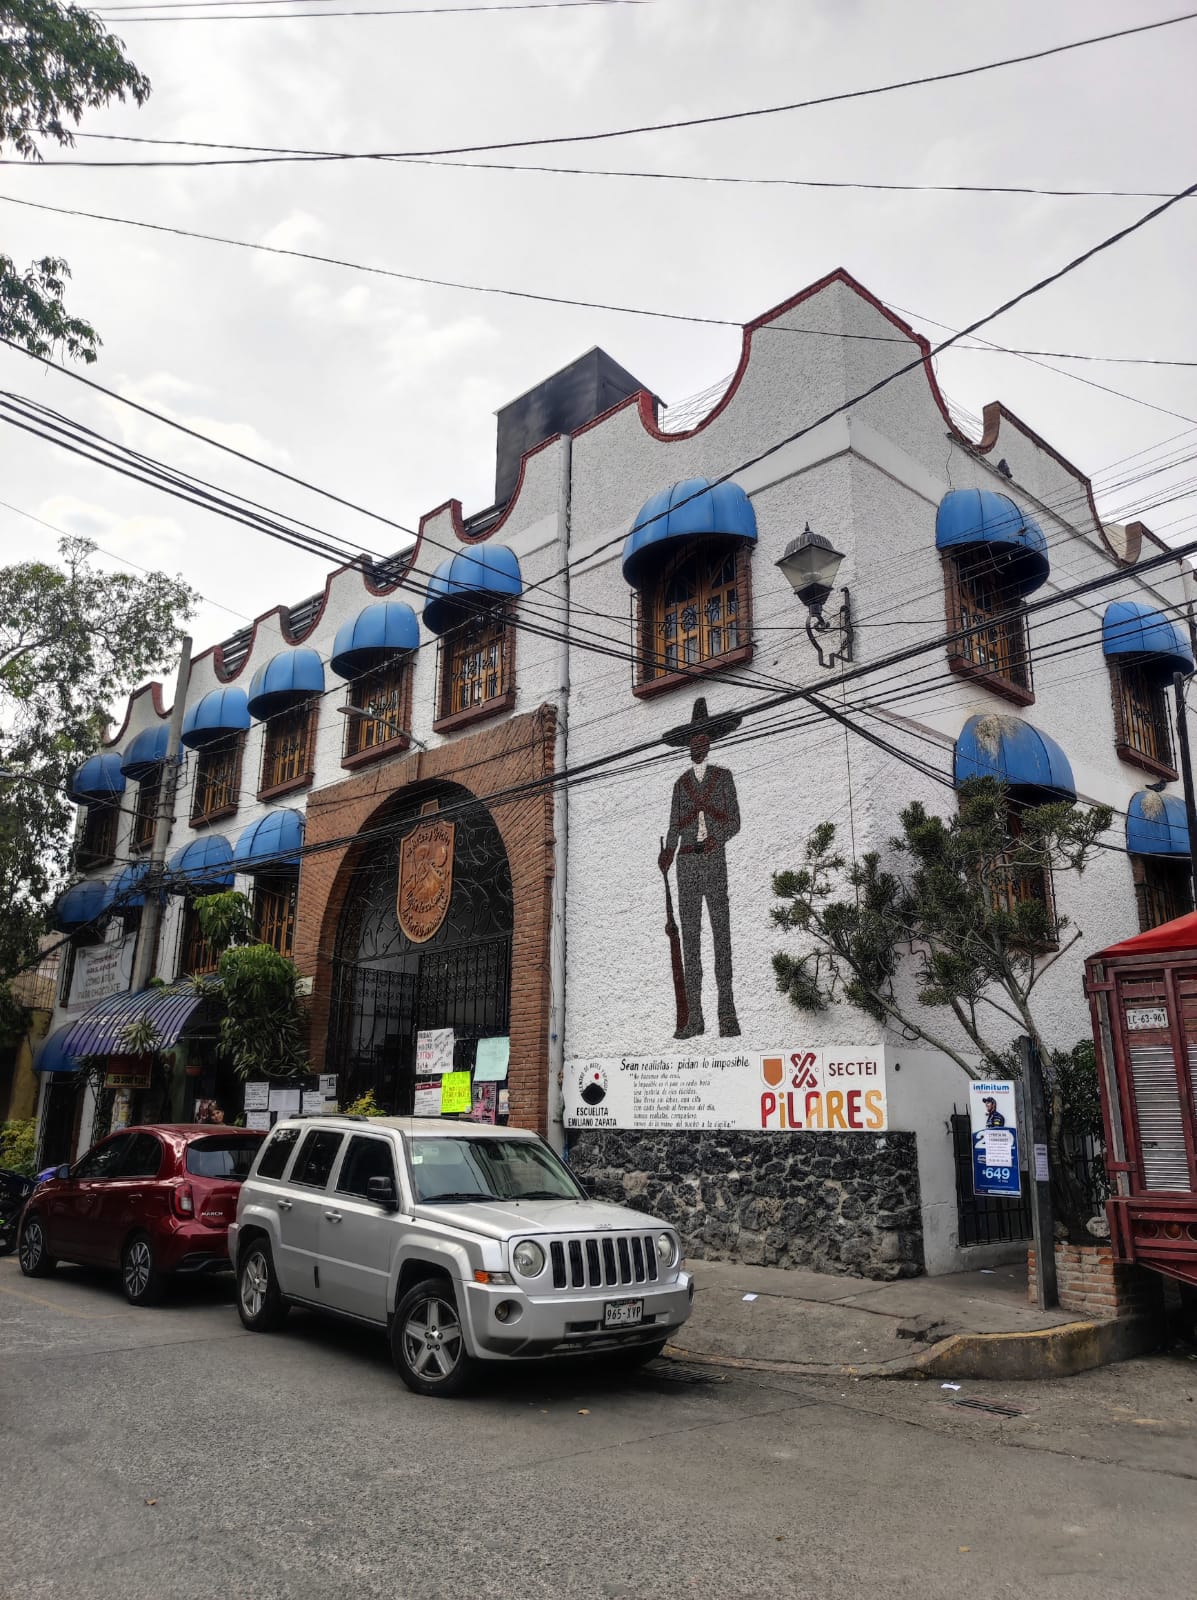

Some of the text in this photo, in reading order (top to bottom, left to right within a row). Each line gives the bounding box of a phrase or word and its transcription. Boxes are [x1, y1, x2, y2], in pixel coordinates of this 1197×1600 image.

[620, 1057, 640, 1072] Sean
[677, 1057, 699, 1073] pidan
[702, 1057, 710, 1069] lo
[711, 1056, 751, 1070] imposible
[829, 1062, 877, 1077] SECTEI
[973, 1083, 1010, 1091] infinitum
[576, 1107, 609, 1117] ESCUELITA
[567, 1117, 617, 1127] EMILIANO ZAPATA
